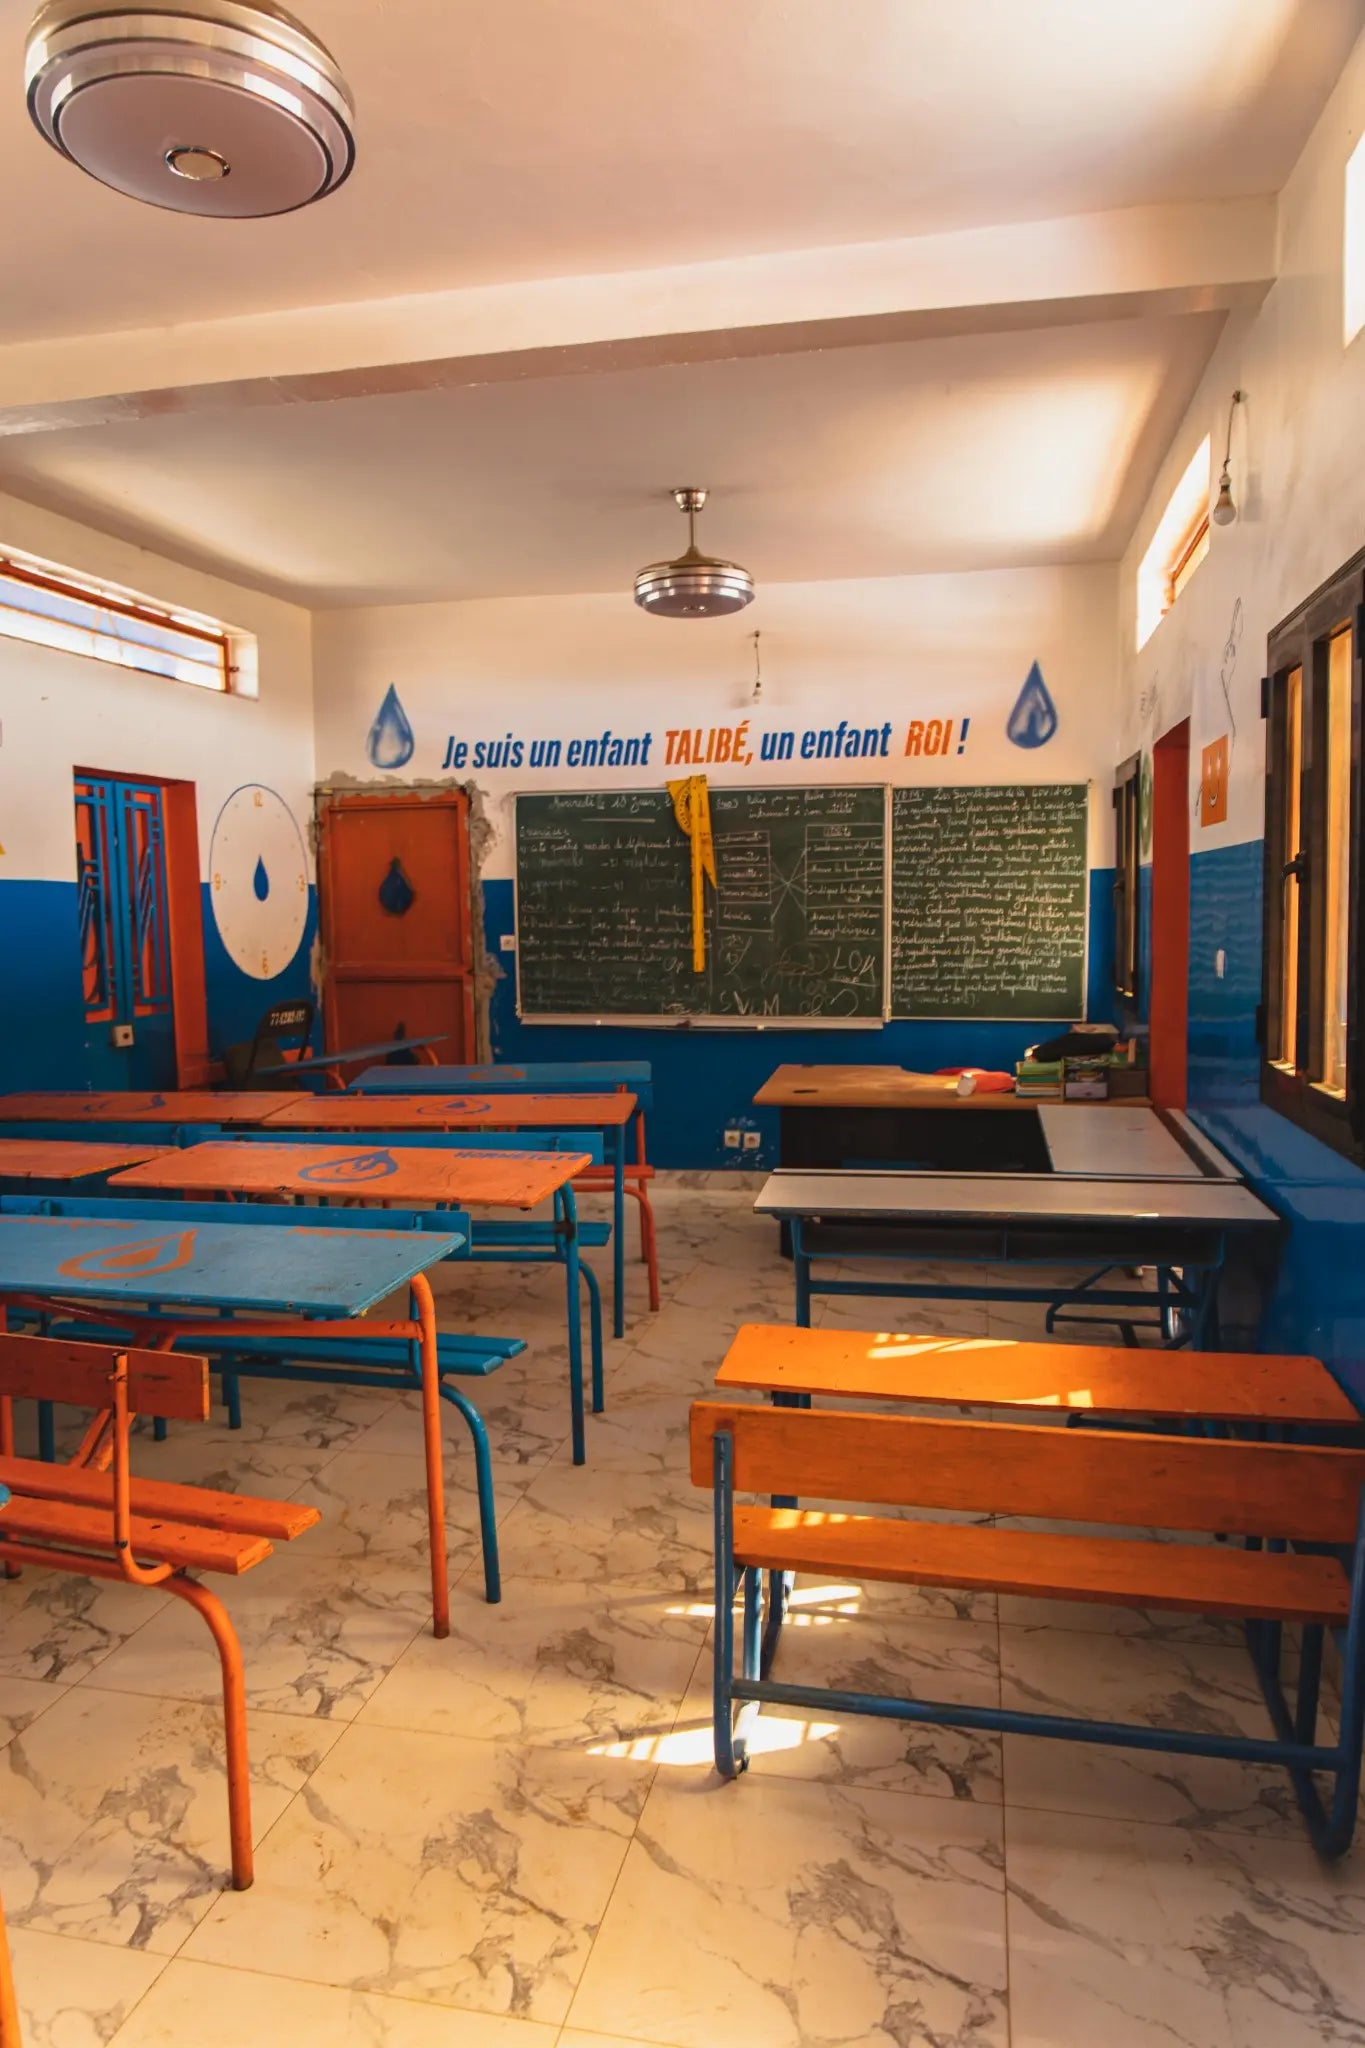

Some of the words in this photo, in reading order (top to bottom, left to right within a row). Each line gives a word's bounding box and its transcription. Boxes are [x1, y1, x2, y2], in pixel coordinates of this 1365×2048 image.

[442, 735, 468, 769] Je
[472, 733, 524, 769] suis
[529, 739, 562, 768] un
[566, 731, 652, 768] enfant
[664, 720, 753, 766] TALIBÉ,
[760, 731, 795, 761] un
[800, 721, 892, 759] enfant
[904, 719, 953, 757] ROI
